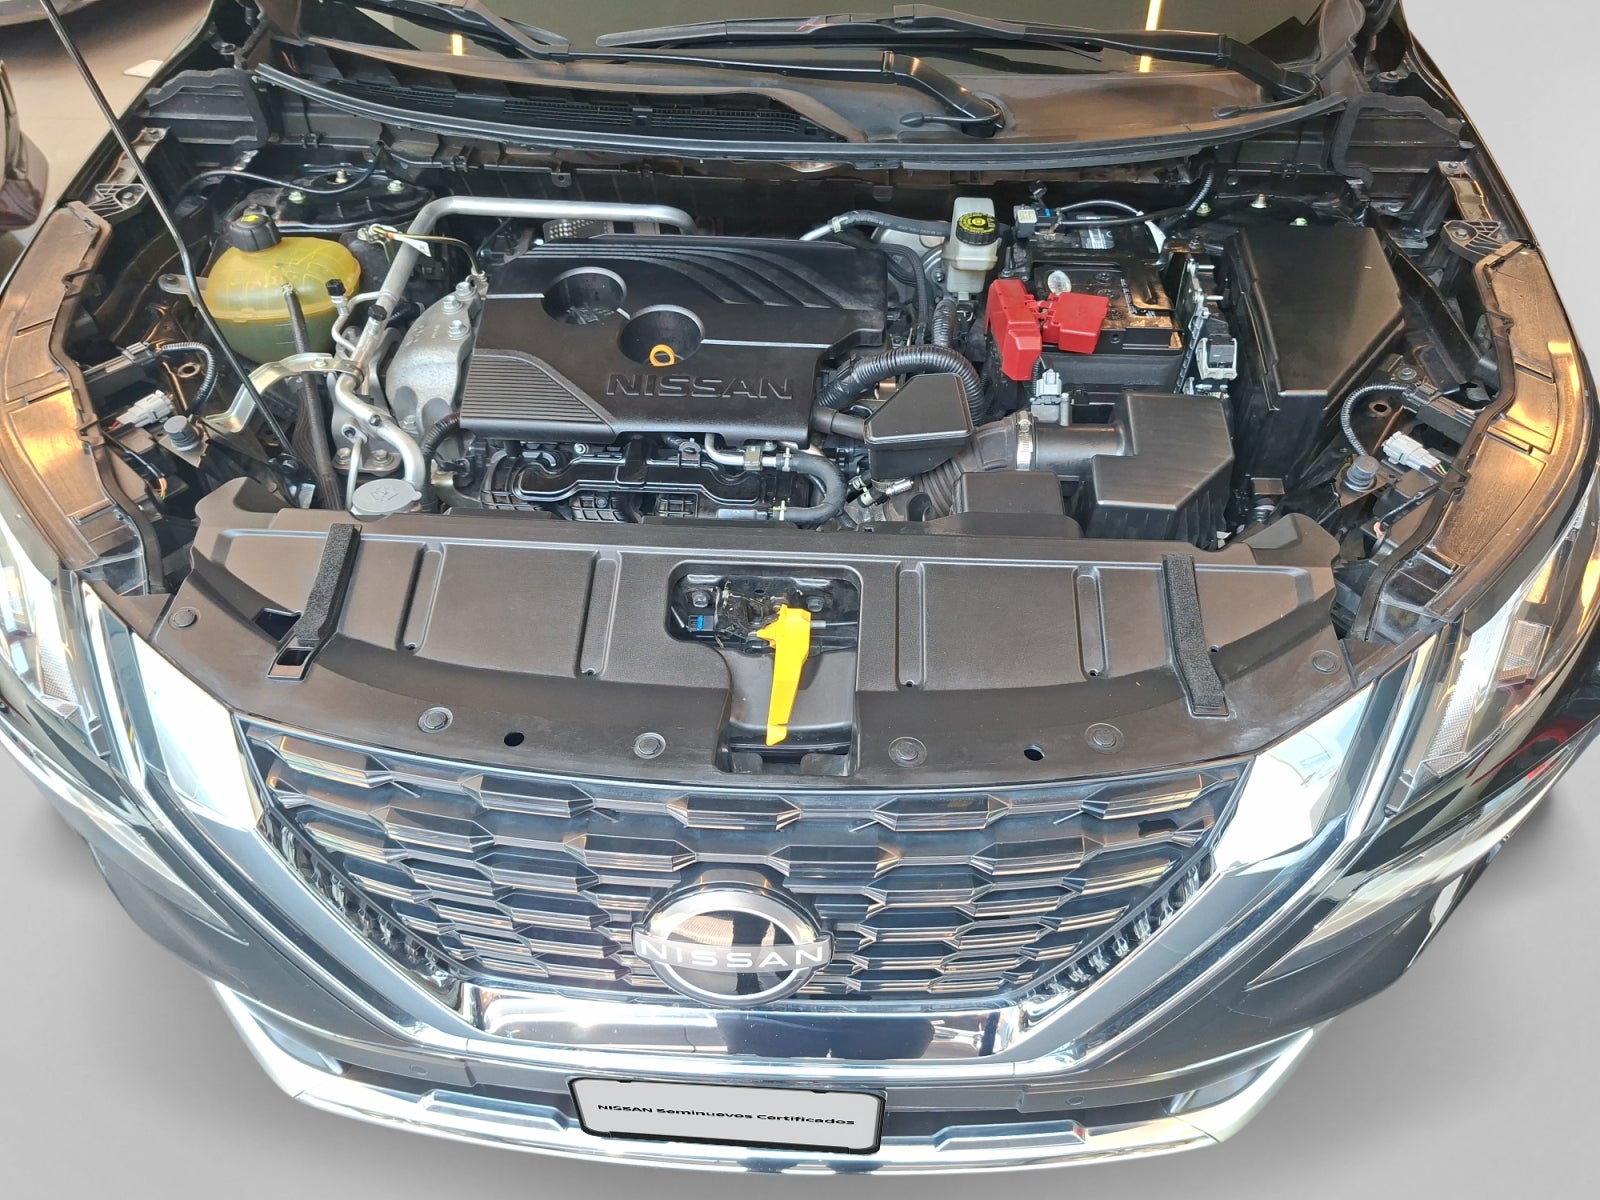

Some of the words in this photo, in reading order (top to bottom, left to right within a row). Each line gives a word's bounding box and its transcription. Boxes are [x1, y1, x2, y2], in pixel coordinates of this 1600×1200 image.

[606, 373, 793, 400] NISSAN
[640, 939, 824, 968] NISSAN
[597, 1104, 653, 1113] NISSAN
[656, 1108, 753, 1119] Seminuevos
[756, 1114, 855, 1125] Certificados
